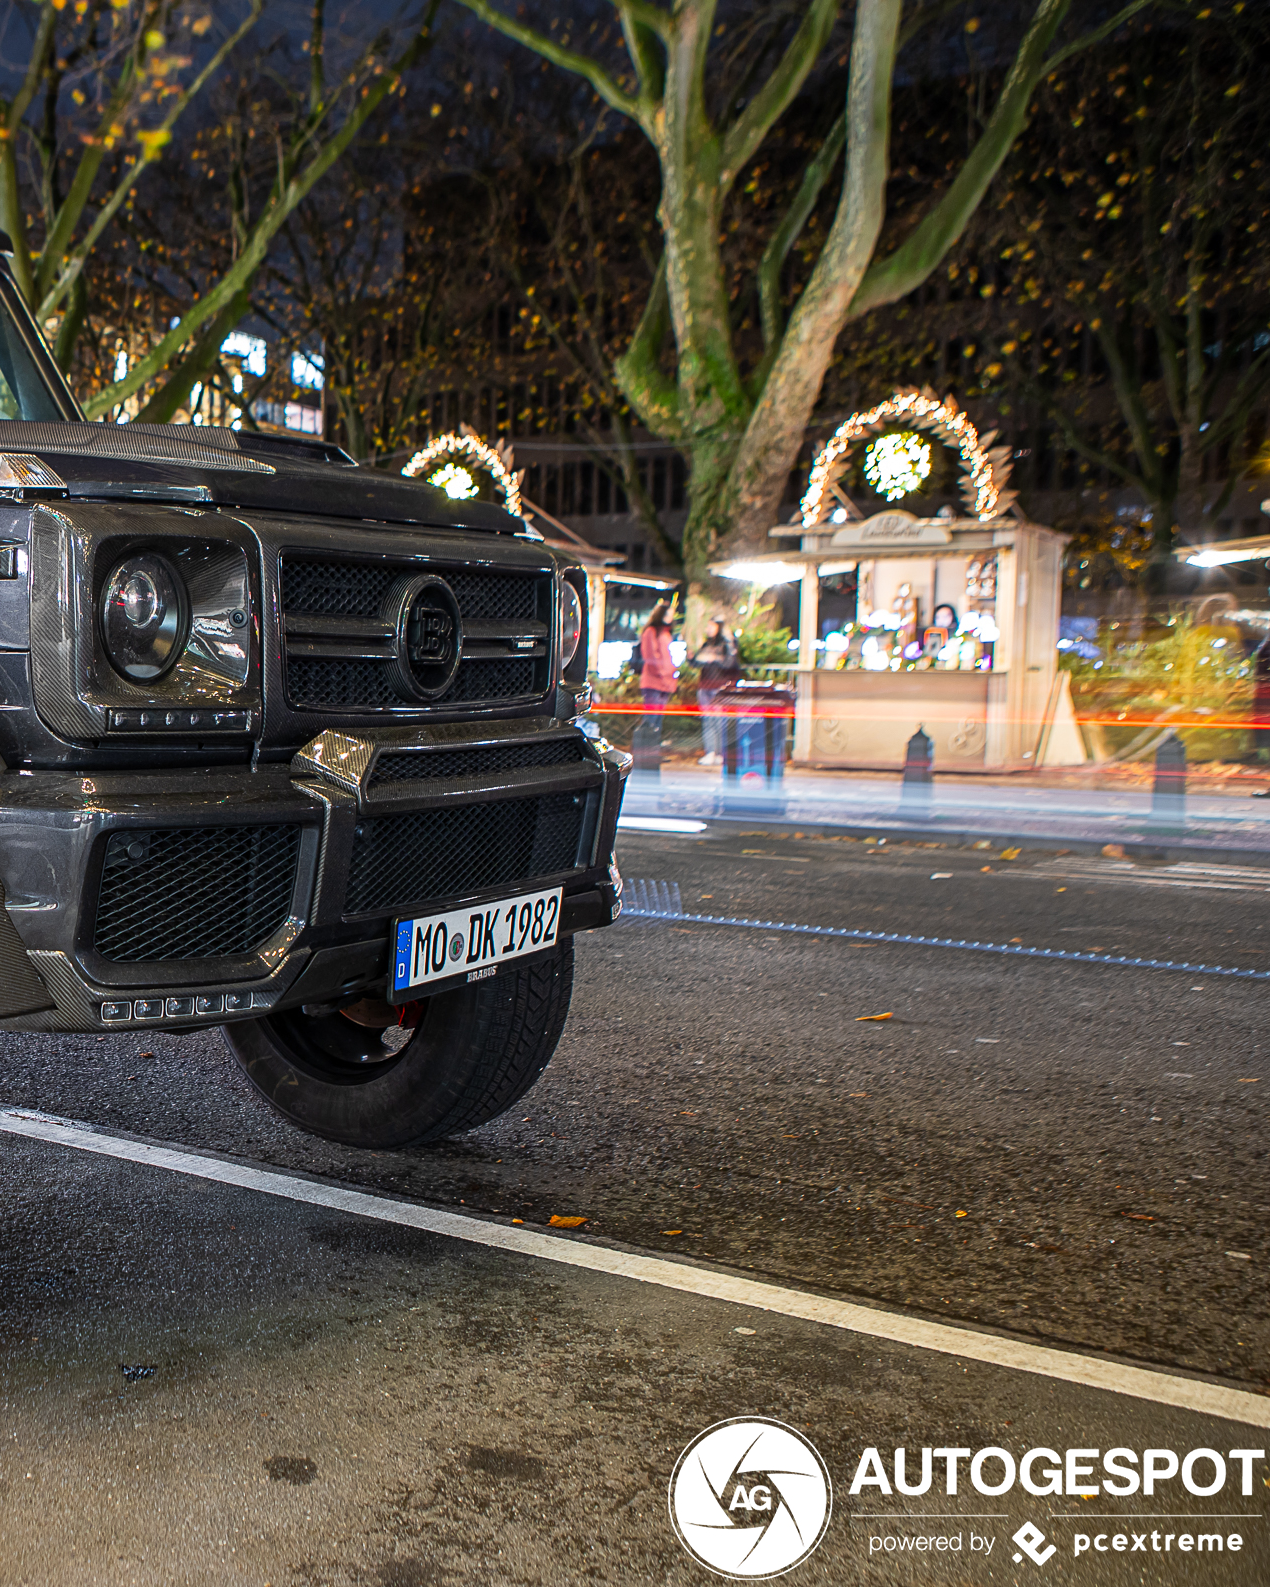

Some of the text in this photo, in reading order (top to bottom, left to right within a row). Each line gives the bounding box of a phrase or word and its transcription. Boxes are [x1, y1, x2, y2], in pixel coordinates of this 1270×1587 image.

[414, 895, 559, 978] MO DK 1982
[398, 963, 406, 979] D
[467, 965, 498, 983] BRABUS
